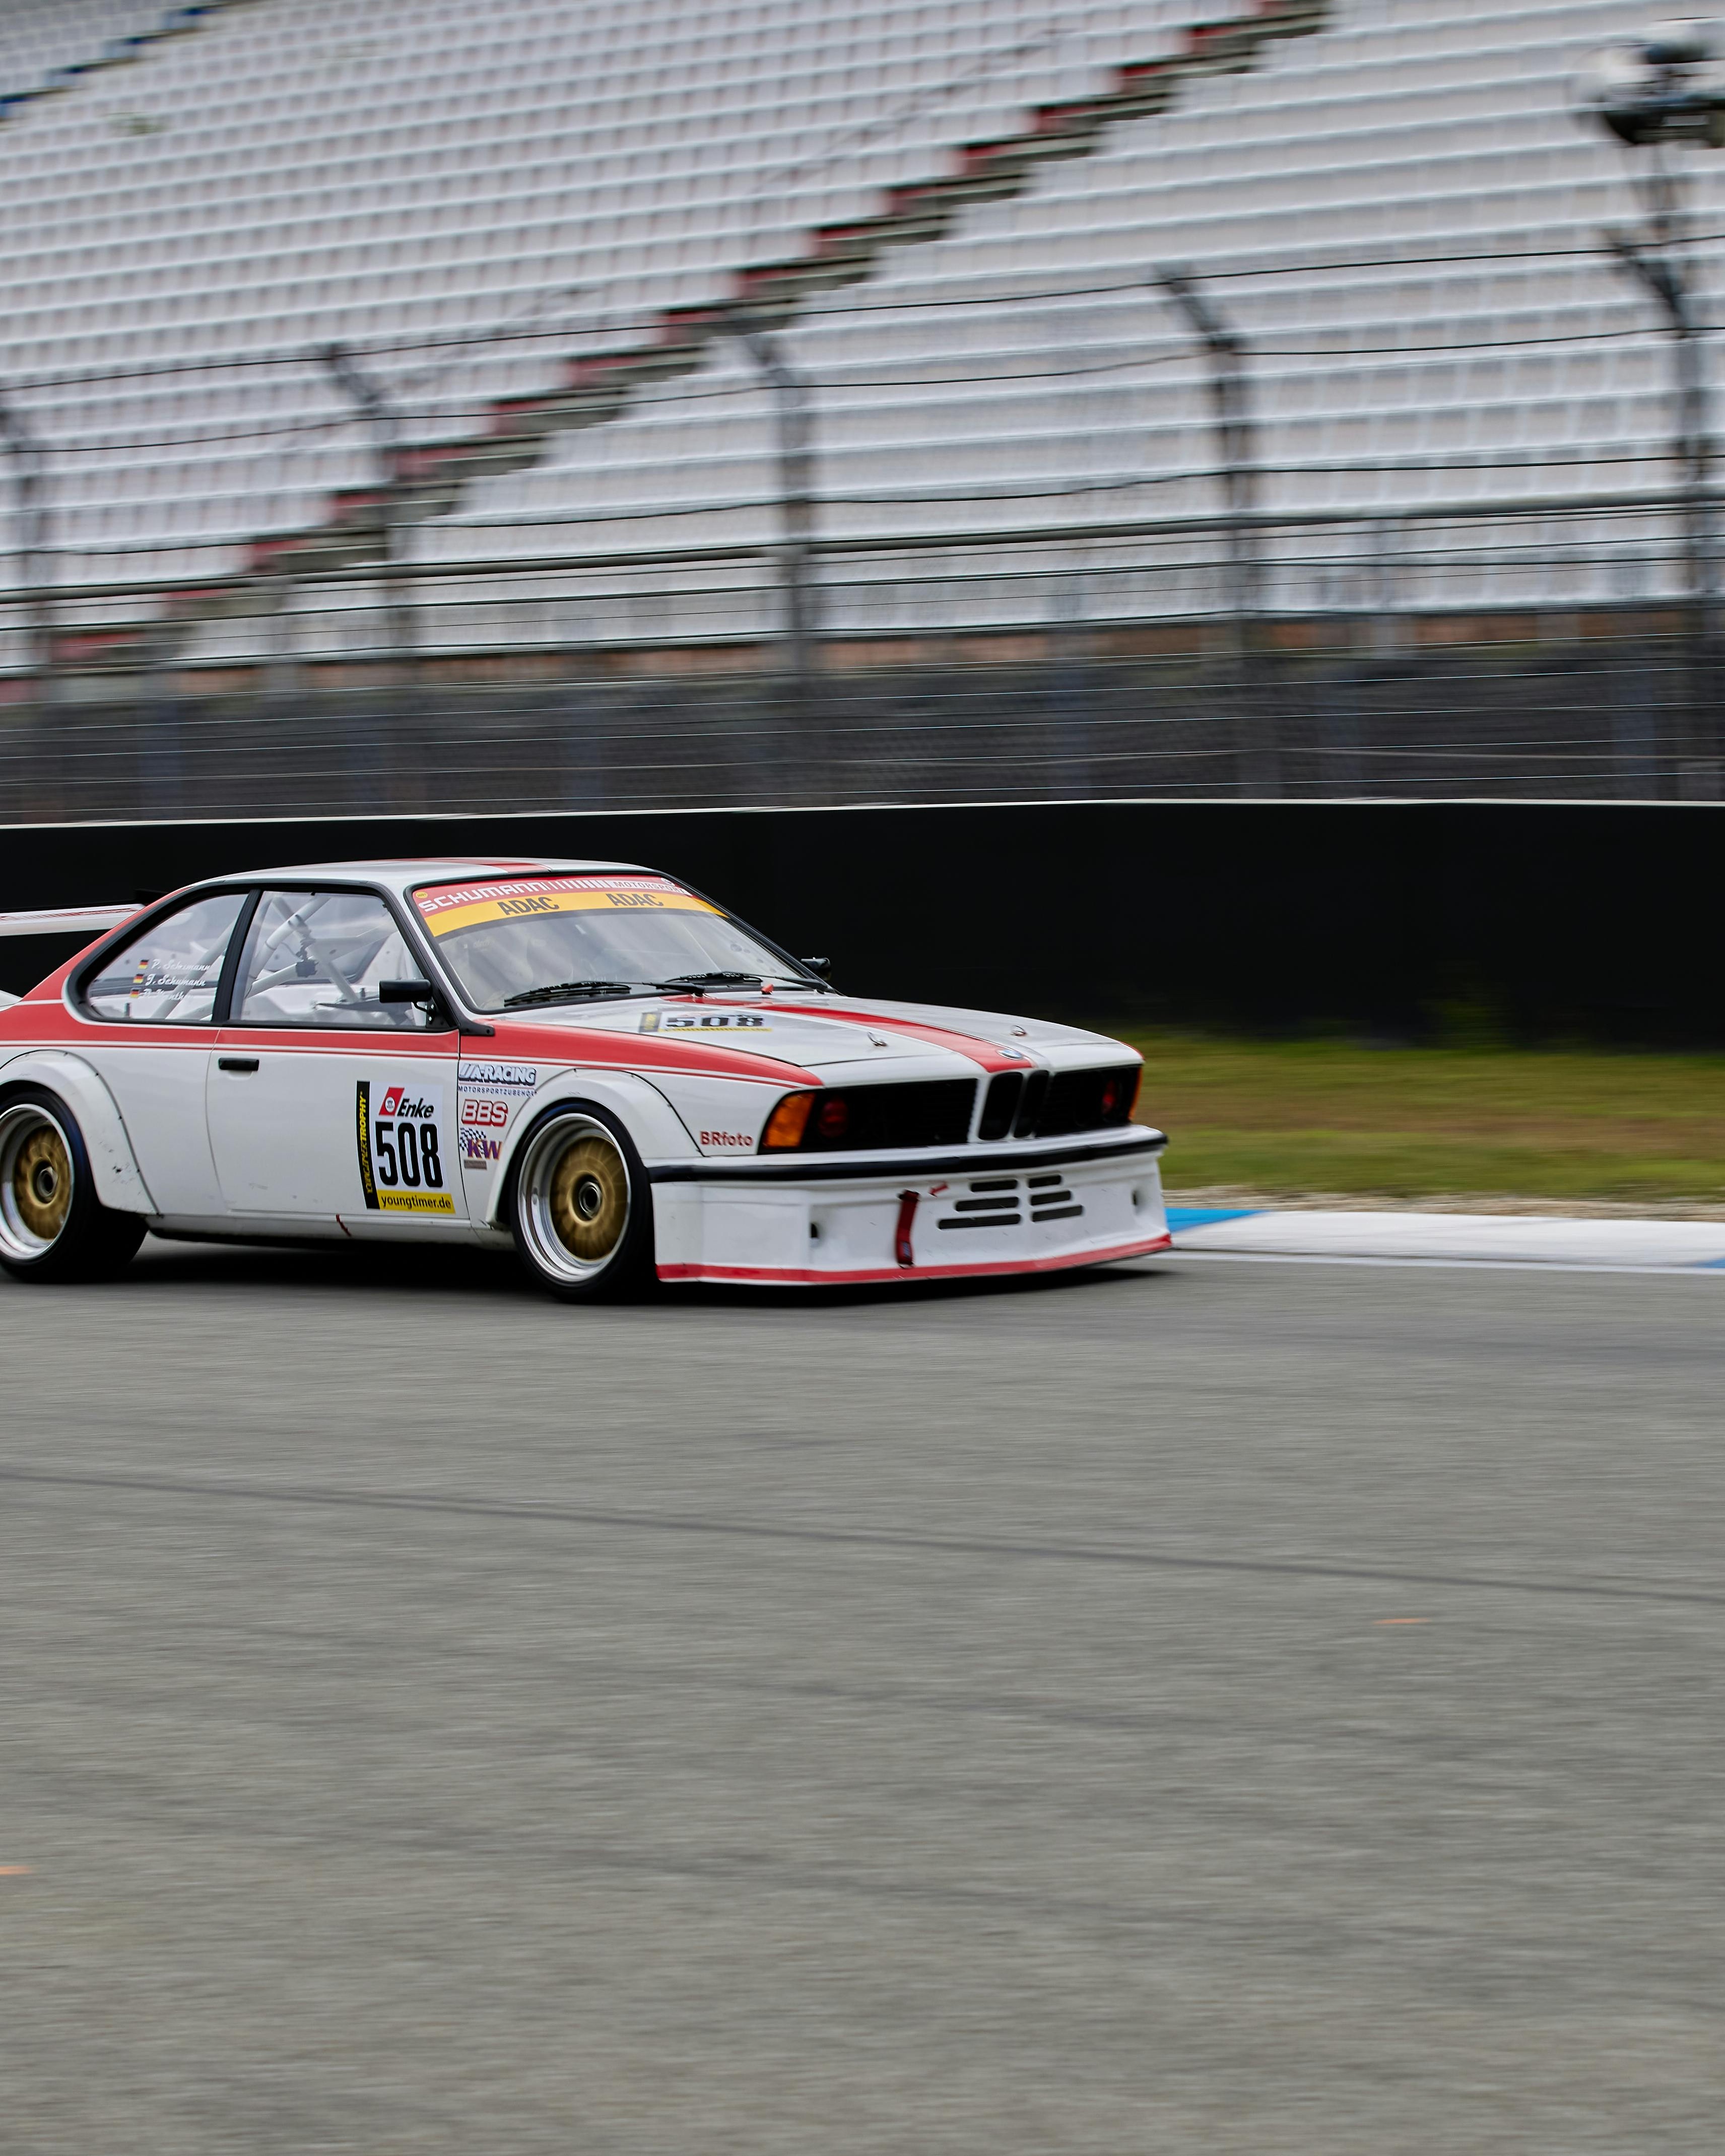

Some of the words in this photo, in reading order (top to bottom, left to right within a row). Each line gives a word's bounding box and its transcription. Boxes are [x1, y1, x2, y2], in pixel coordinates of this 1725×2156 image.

[418, 883, 549, 912] SCHUMANN
[497, 897, 559, 915] ADAC
[606, 893, 664, 906] ADAC
[157, 974, 206, 986] Schumann
[667, 1016, 763, 1027] 508
[397, 1098, 434, 1118] Enke
[461, 1099, 508, 1127] BBS
[700, 1131, 753, 1146] BRfoto
[375, 1121, 443, 1188] 508
[468, 1138, 503, 1161] KW
[381, 1194, 451, 1209] youngtimer.de
